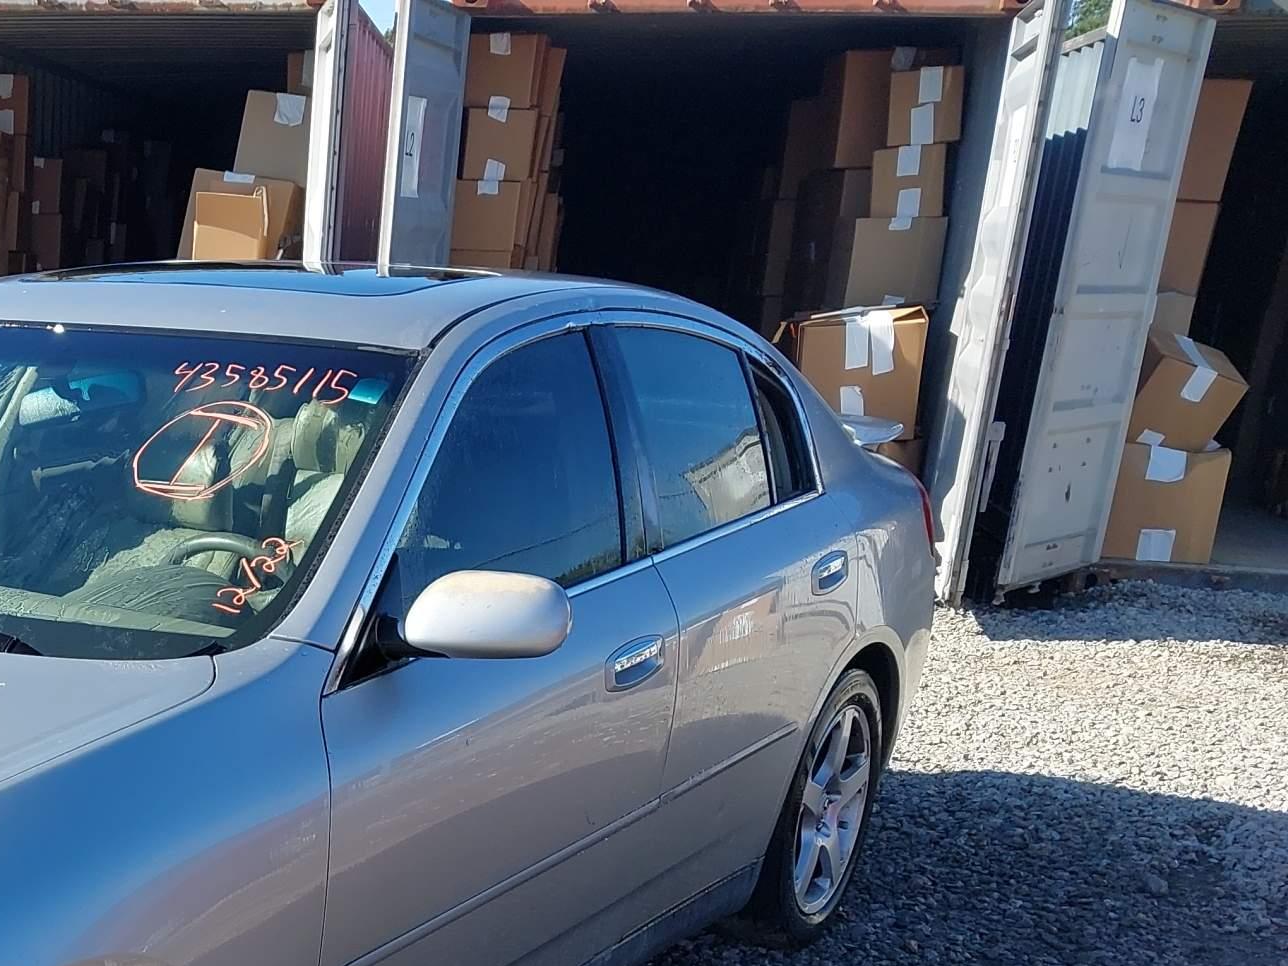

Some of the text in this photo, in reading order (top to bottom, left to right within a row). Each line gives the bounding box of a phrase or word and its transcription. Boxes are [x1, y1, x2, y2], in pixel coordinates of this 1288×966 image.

[1129, 95, 1146, 123] L3
[404, 130, 414, 156] L2
[173, 361, 357, 405] 43585115
[210, 536, 305, 615] 12/22
